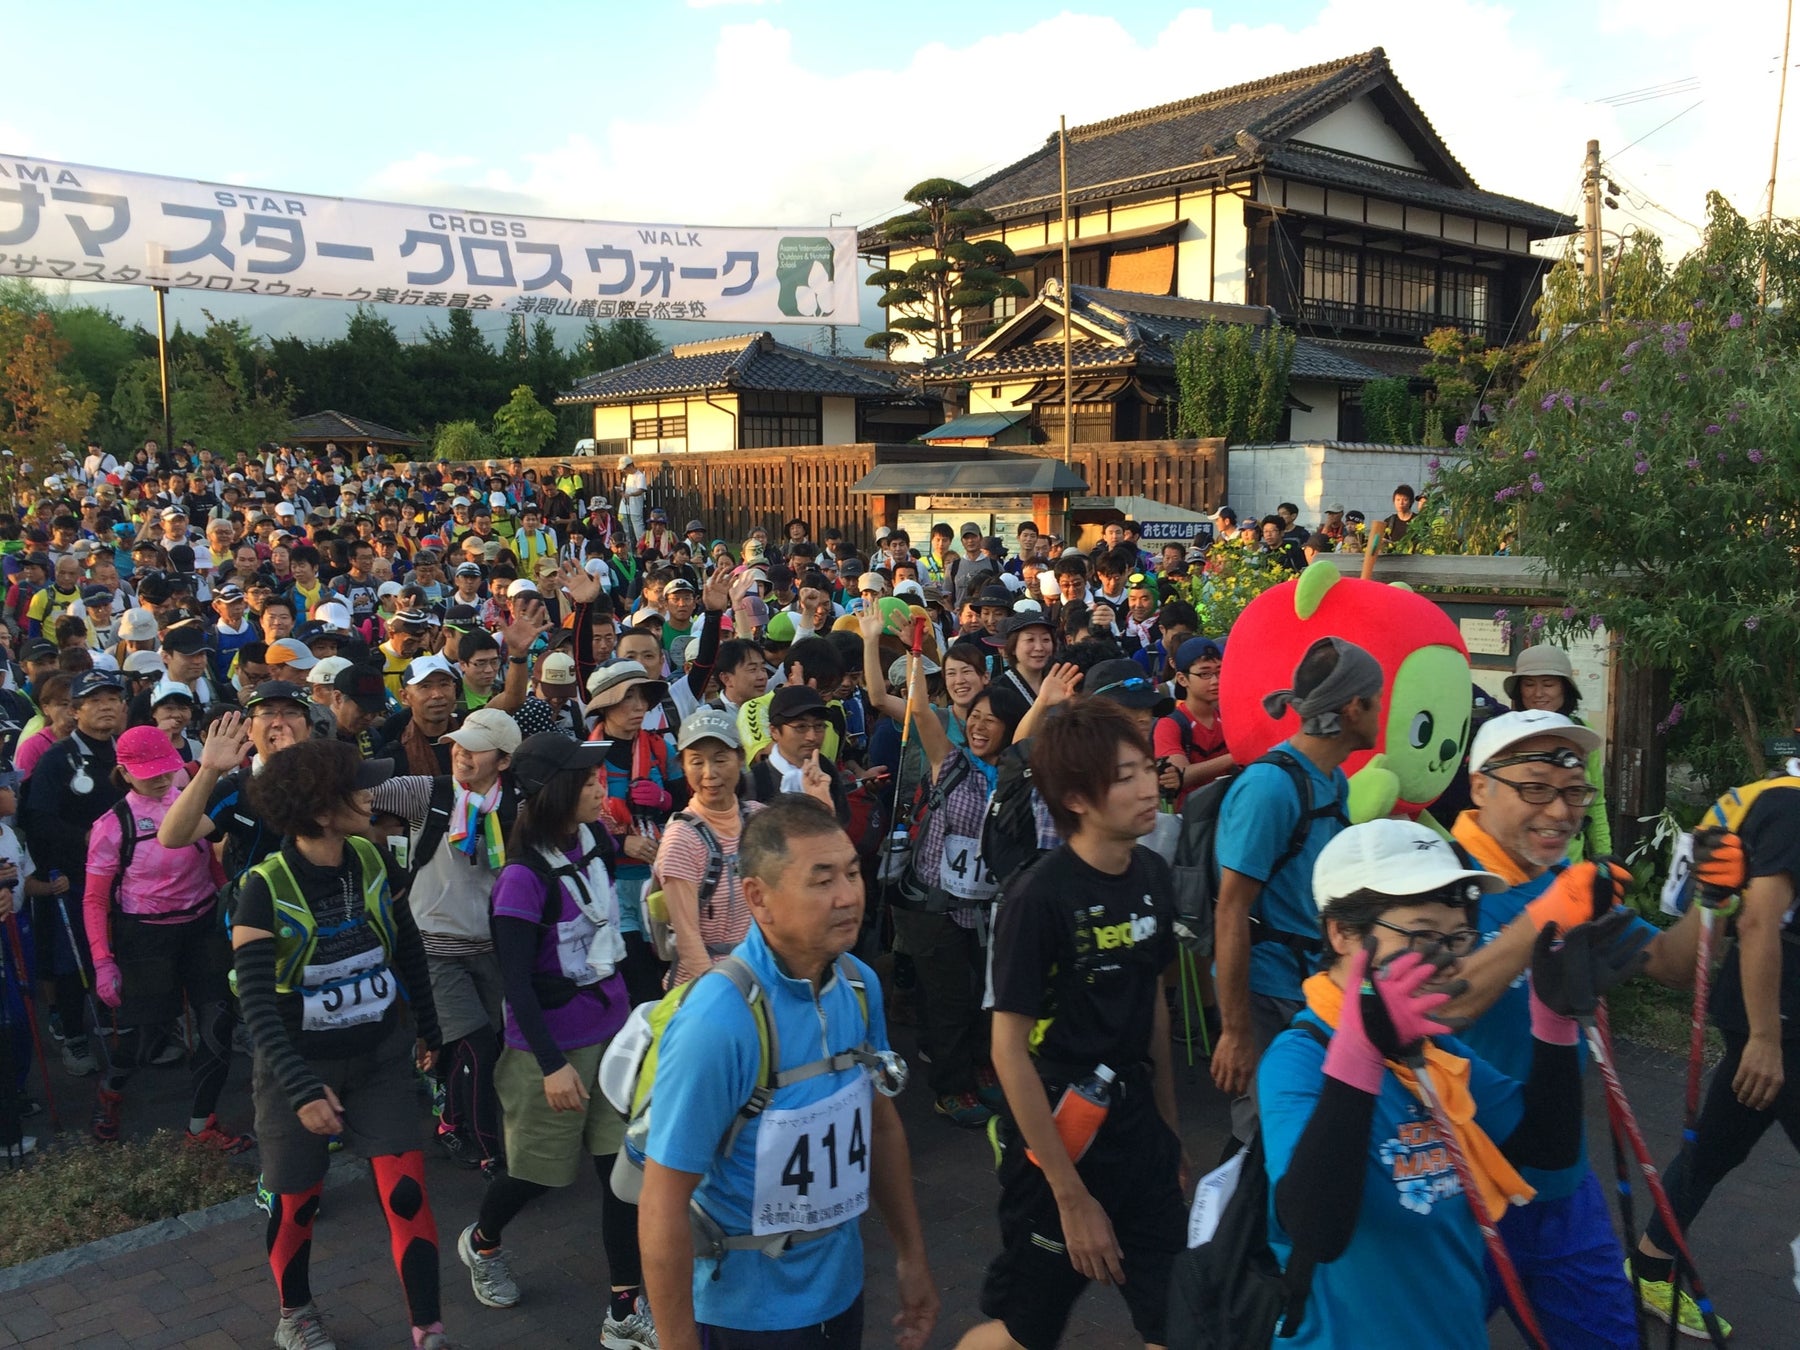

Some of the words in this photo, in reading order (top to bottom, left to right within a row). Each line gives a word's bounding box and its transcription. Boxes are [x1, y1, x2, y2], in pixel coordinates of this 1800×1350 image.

[161, 202, 374, 274] スター
[399, 229, 573, 294] クロス
[585, 244, 760, 298] ウォーク
[214, 191, 307, 216] STAR
[428, 213, 527, 238] CROSS
[637, 230, 702, 247] WALK
[781, 1107, 866, 1196] 414
